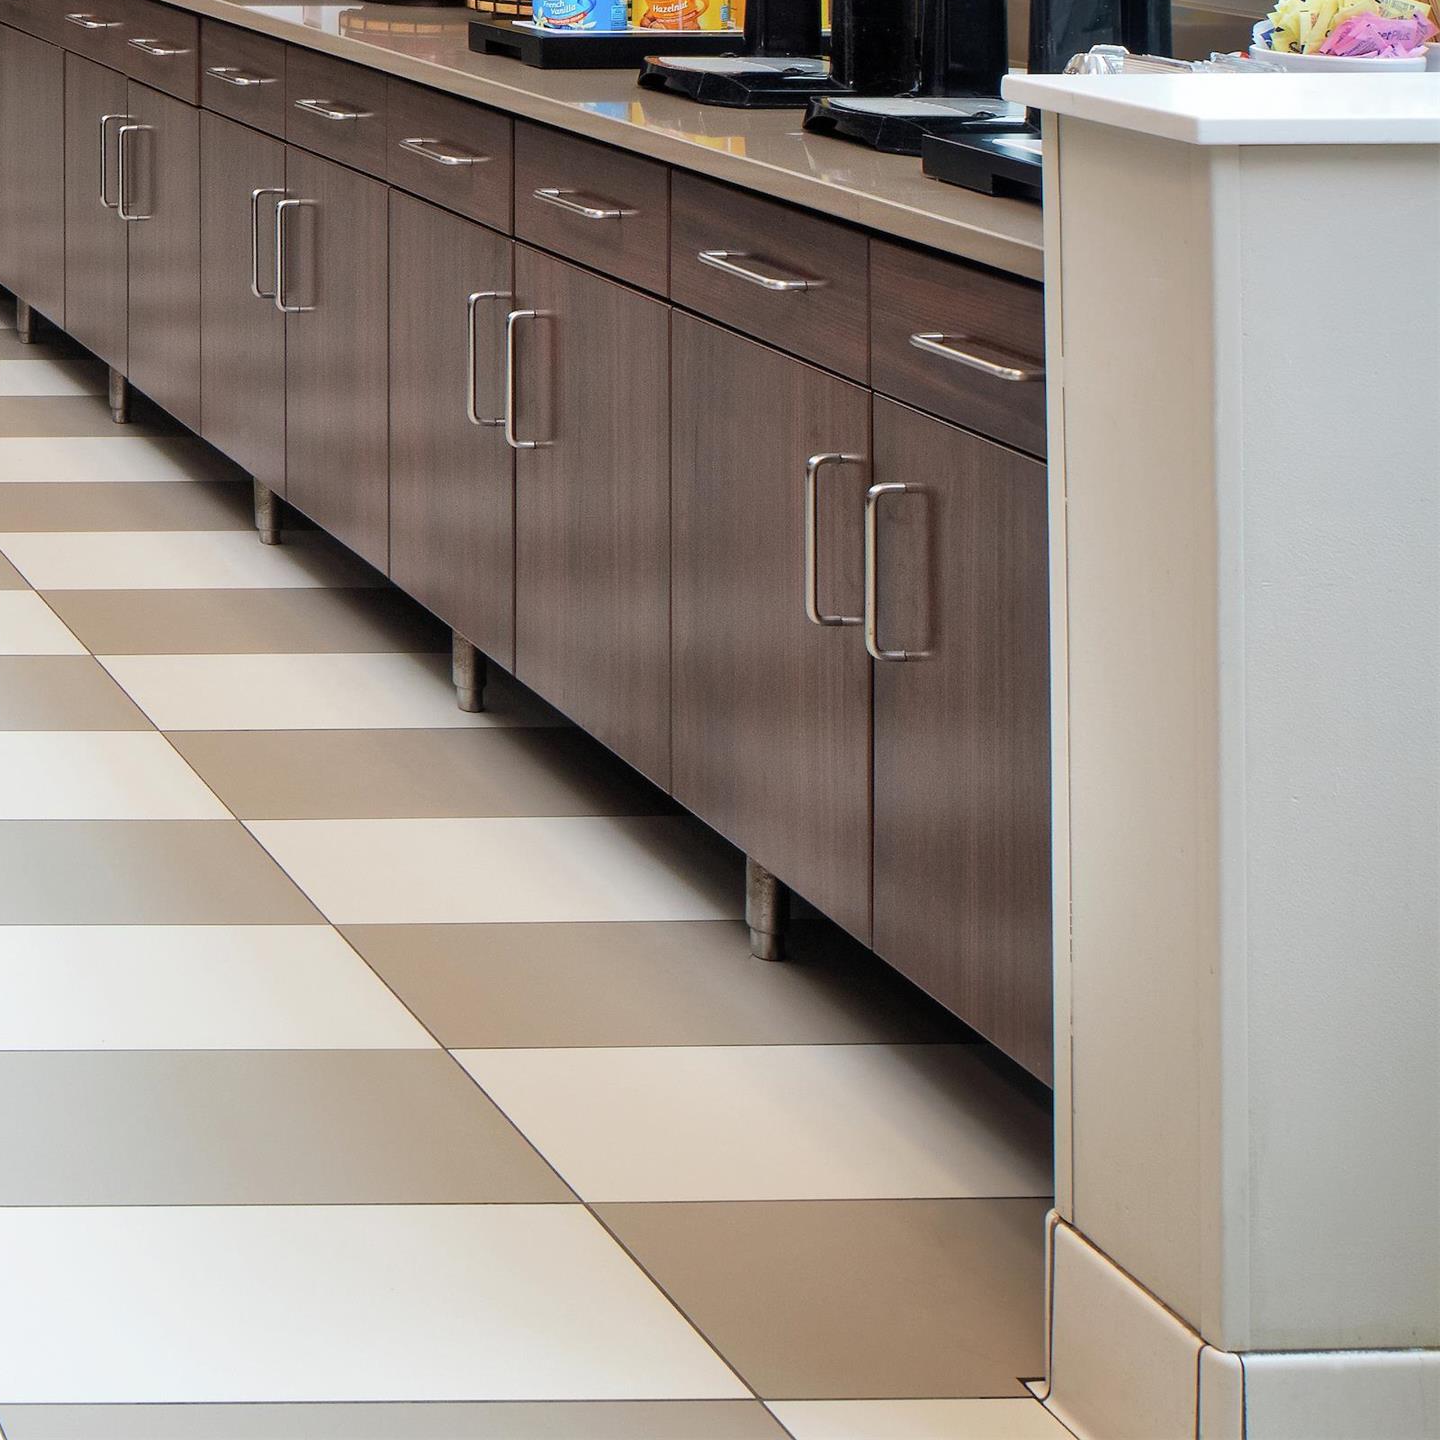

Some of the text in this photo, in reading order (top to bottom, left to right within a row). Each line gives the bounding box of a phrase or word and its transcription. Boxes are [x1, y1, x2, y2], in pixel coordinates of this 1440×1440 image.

[544, 0, 565, 8] French
[550, 3, 576, 15] Vanilla
[652, 0, 689, 13] Hazelnut
